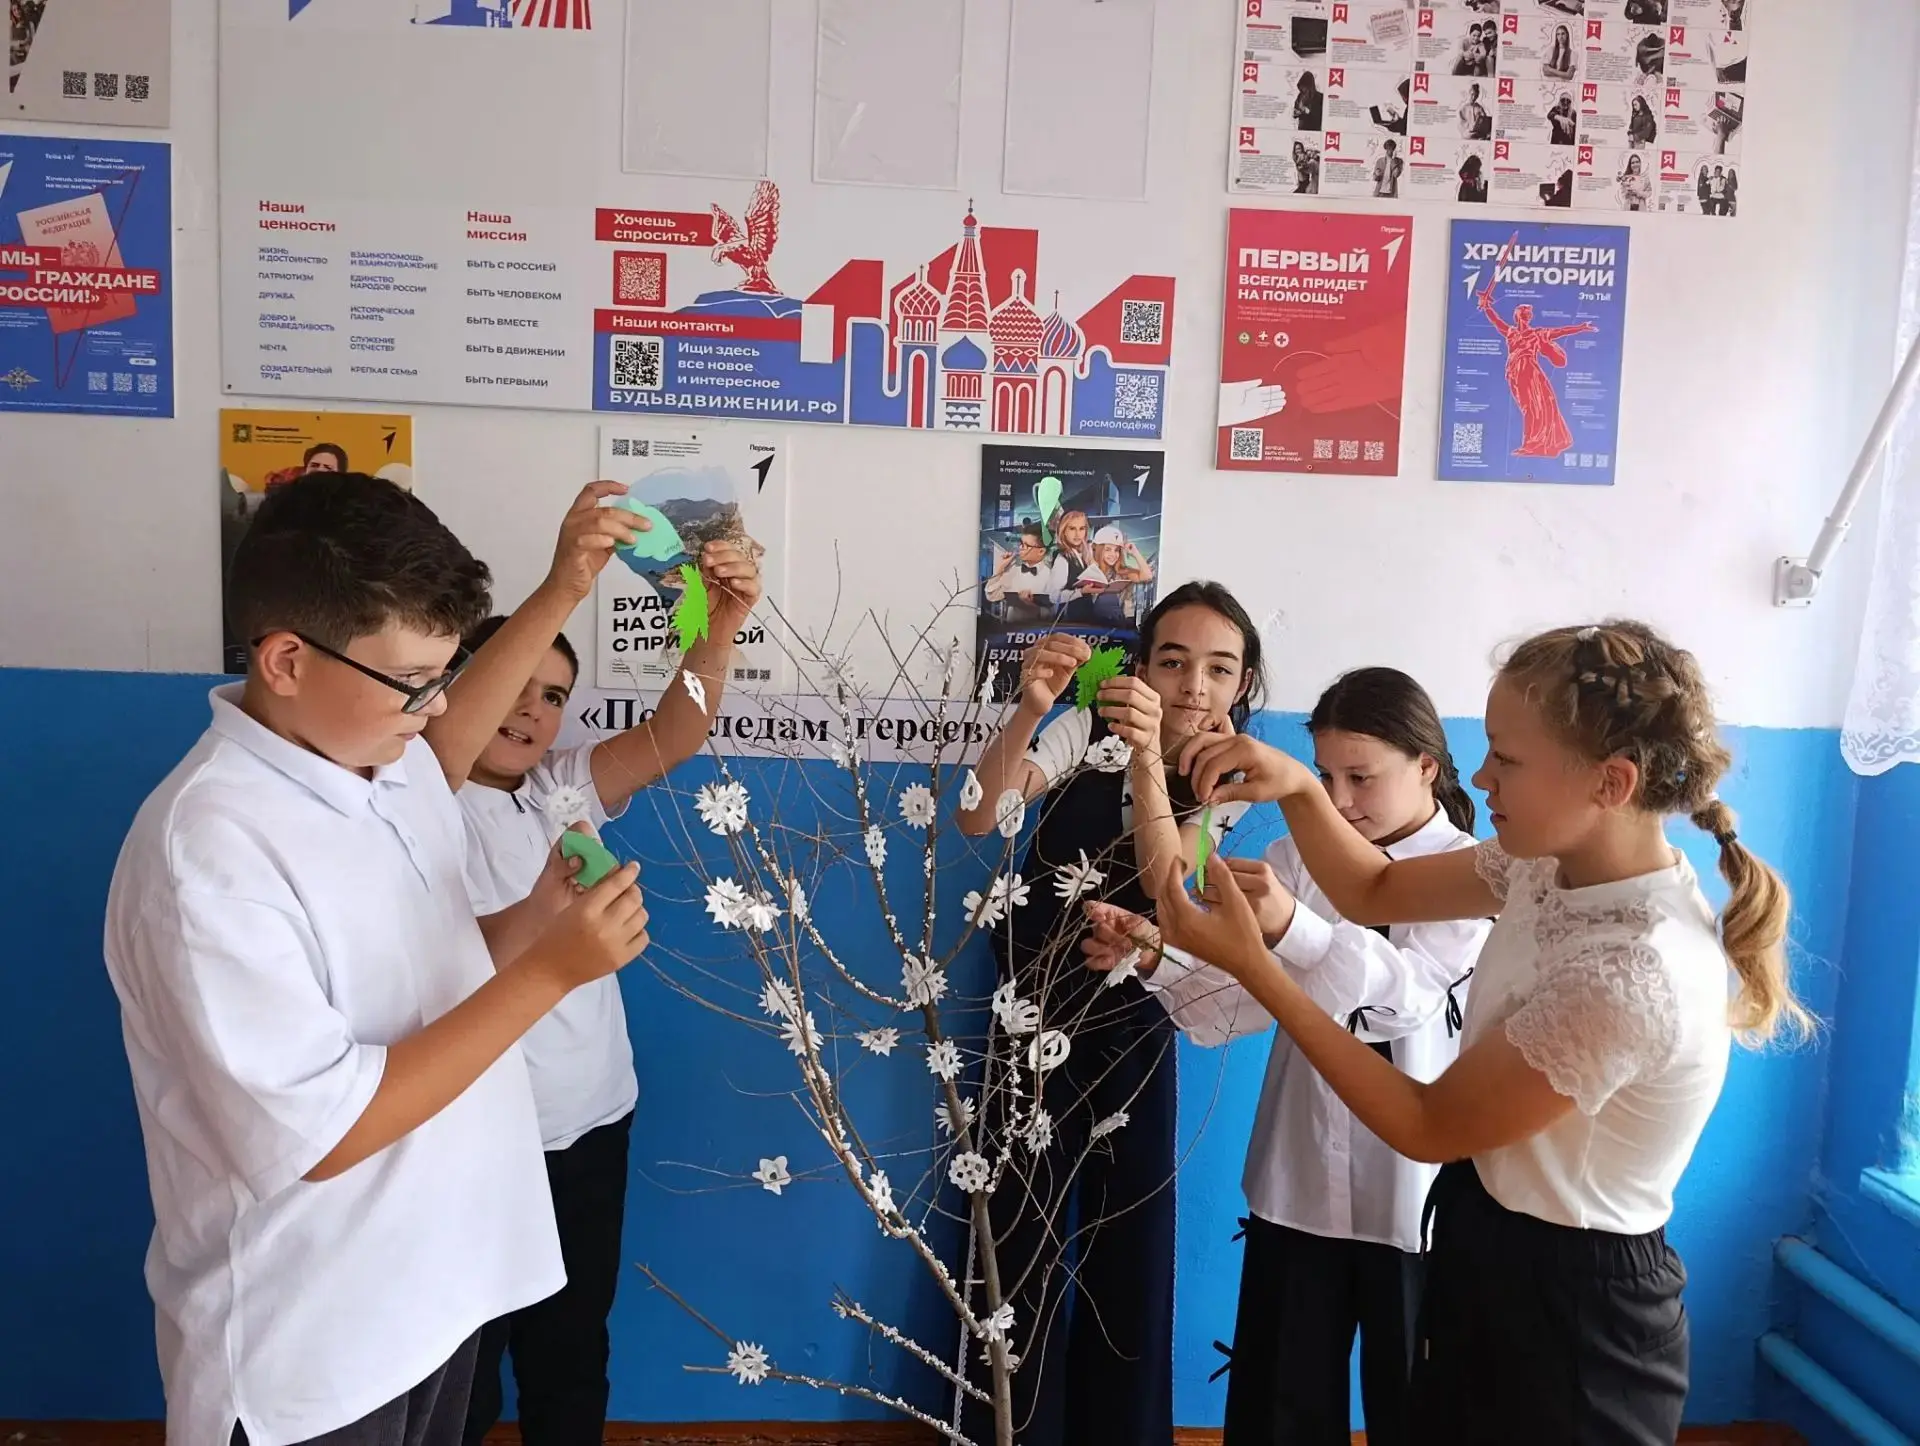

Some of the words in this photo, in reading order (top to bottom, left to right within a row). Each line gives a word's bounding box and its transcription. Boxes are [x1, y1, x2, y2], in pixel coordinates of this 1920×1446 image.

[1422, 14, 1430, 24] Р
[1506, 18, 1515, 28] С
[1590, 23, 1599, 33] Т
[1673, 29, 1682, 39] У
[1246, 66, 1257, 78] Ф
[1332, 71, 1342, 82] Х
[1417, 76, 1426, 89] Ц
[1327, 135, 1338, 146] Ы
[1580, 151, 1592, 161] Ю
[1663, 154, 1674, 165] Я
[260, 200, 305, 214] Наши
[35, 207, 92, 227] РОССИЙСКАЯ
[467, 211, 512, 224] Наша
[614, 213, 677, 228] Хочешь
[42, 218, 92, 235] ФЕДЕРАЦИЯ
[260, 219, 336, 232] ценности
[467, 230, 527, 241] миссия
[614, 229, 699, 243] спросить?
[259, 247, 289, 255] ЖИЗНЬ
[350, 251, 424, 262] ВЗАИМОПОМОЩЬ
[1463, 242, 1616, 266] ХРАНИТЕЛИ
[267, 255, 328, 265] ДОСТОИНСТВО
[358, 260, 438, 270] ВЗАИМОУВАЖЕНИЕ
[467, 260, 496, 269] БЫТЬ
[498, 261, 505, 269] С
[507, 262, 556, 271] РОССИЕЙ
[1239, 247, 1370, 273] ПЕРВЫЙ
[35, 270, 157, 290] ГРАЖДАНЕ
[259, 272, 314, 281] ПАТРИОТИЗМ
[350, 275, 395, 284] ЕДИНСТВО
[1494, 265, 1615, 287] ИСТОРИИ
[350, 282, 391, 291] НАРОДОВ
[393, 284, 427, 293] РОССИИ
[1239, 274, 1300, 289] ВСЕГДА
[1303, 277, 1368, 292] ПРИДЕТ
[259, 292, 295, 300] ДРУЖБА
[467, 288, 495, 297] БЫТЬ
[497, 290, 562, 300] ЧЕЛОВЕКОМ
[1238, 288, 1260, 300] НА
[1262, 290, 1344, 306] ПОМОЩЬ!
[1579, 292, 1595, 301] Это
[350, 306, 415, 316] ИСТОРИЧЕСКАЯ
[260, 314, 288, 322] ДОБРО
[350, 313, 385, 322] ПАМЯТЬ
[466, 316, 495, 325] БЫТЬ
[497, 318, 539, 328] ВМЕСТЕ
[260, 321, 335, 331] СПРАВЕДЛИВОСТЬ
[613, 315, 658, 329] Наши
[661, 317, 734, 333] контакты
[350, 335, 396, 345] СЛУЖЕНИЕ
[260, 343, 288, 352] МЕЧТА
[350, 343, 396, 352] ОТЕЧЕСТВУ
[466, 344, 495, 353] БЫТЬ
[496, 346, 503, 354] В
[505, 346, 565, 357] ДВИЖЕНИИ
[679, 342, 713, 355] Ищи
[716, 345, 760, 357] здесь
[260, 364, 333, 375] СОЗИДАТЕЛЬНЫЙ
[350, 366, 389, 375] КРЕПКАЯ
[390, 367, 418, 376] СЕМЬЯ
[678, 360, 705, 370] все
[708, 361, 754, 372] новое
[260, 372, 282, 381] ТРУД
[465, 375, 494, 384] БЫТЬ
[496, 377, 549, 387] ПЕРВЫМИ
[678, 375, 687, 384] и
[690, 376, 781, 389] интересное
[610, 391, 837, 415] БУДЬВДВИЖЕНИИ.РФ
[1080, 419, 1156, 431] росмолодёжь
[750, 444, 776, 452] Первые
[1006, 460, 1030, 468] работе
[613, 595, 675, 612] БУДЬ
[613, 617, 646, 632] НА
[613, 637, 629, 653] С
[708, 715, 832, 746] ледам
